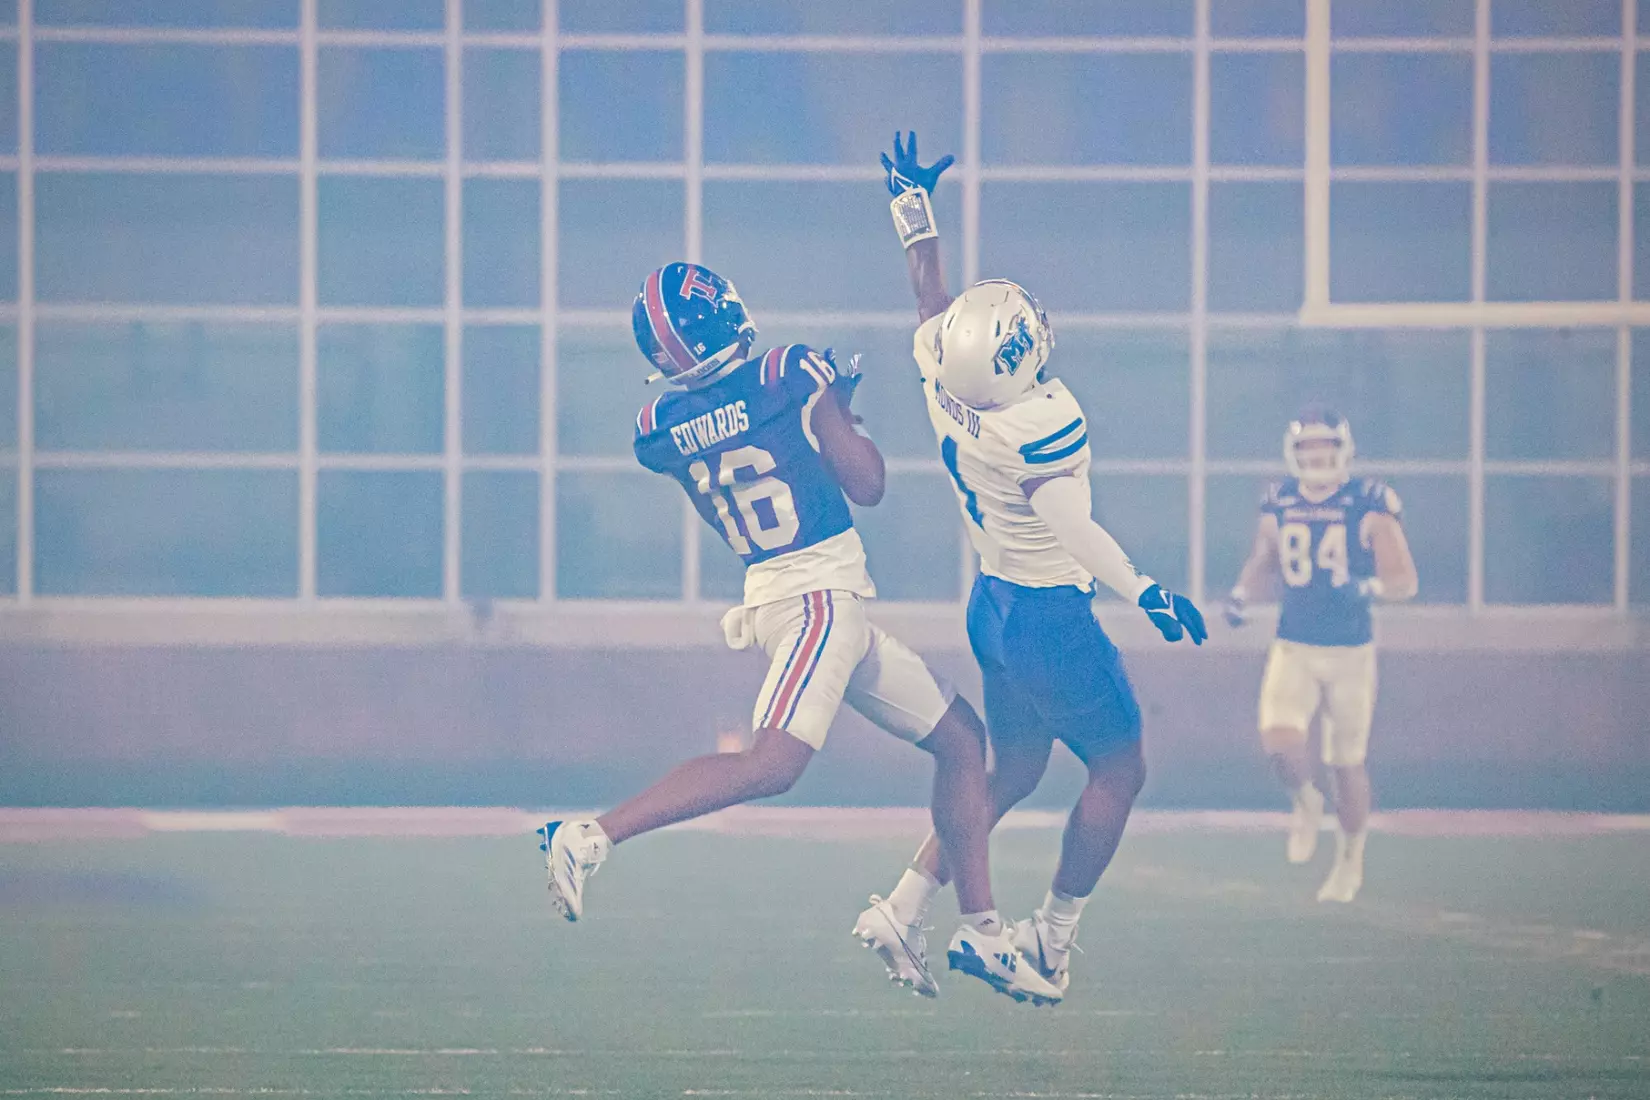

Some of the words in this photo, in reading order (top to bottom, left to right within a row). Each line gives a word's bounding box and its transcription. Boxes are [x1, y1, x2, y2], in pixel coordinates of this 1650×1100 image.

[694, 342, 706, 355] 16
[800, 351, 835, 387] 16
[670, 400, 749, 455] EDWARDS
[966, 409, 981, 439] III
[689, 445, 799, 555] 16
[942, 435, 985, 530] 1
[1279, 523, 1349, 588] 84
